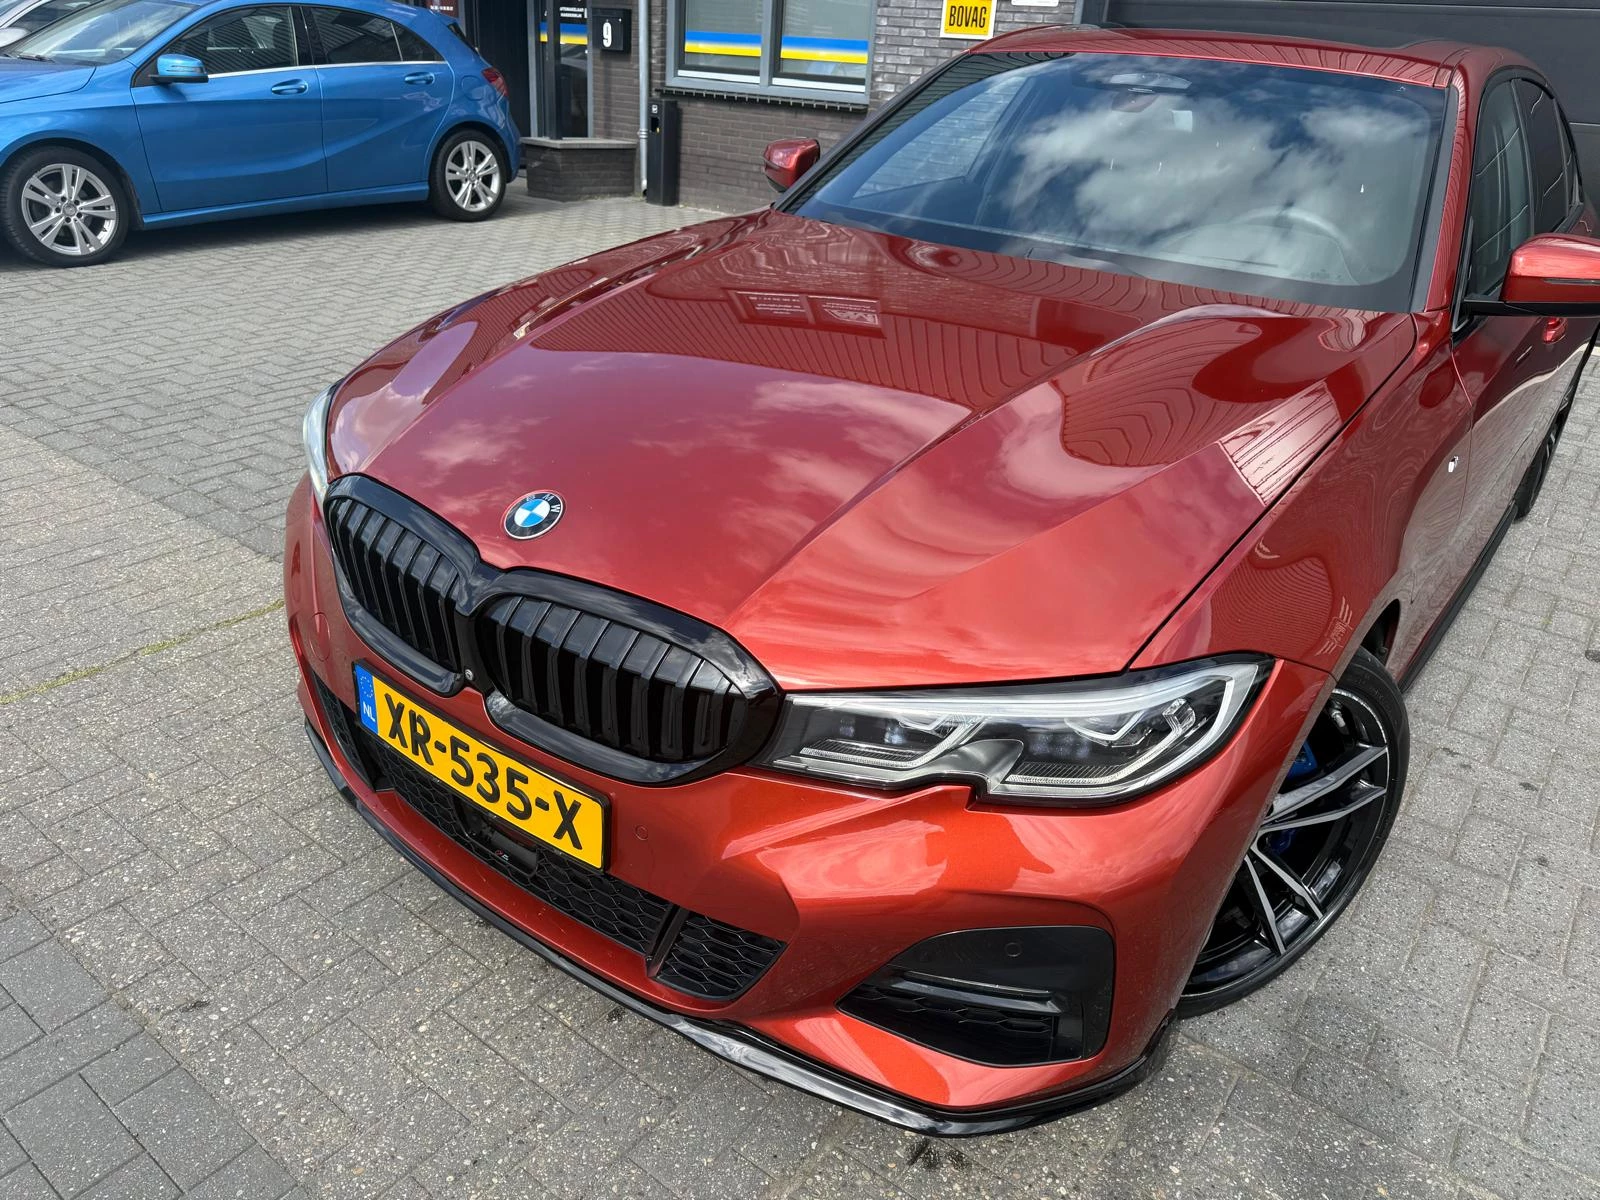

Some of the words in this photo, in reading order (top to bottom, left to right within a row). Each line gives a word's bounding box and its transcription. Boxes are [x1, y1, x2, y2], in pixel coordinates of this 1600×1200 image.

[948, 5, 987, 29] BOVAG
[602, 22, 612, 48] 9
[526, 493, 561, 513] BMW
[363, 703, 376, 722] NL
[384, 692, 583, 850] XR-535-X
